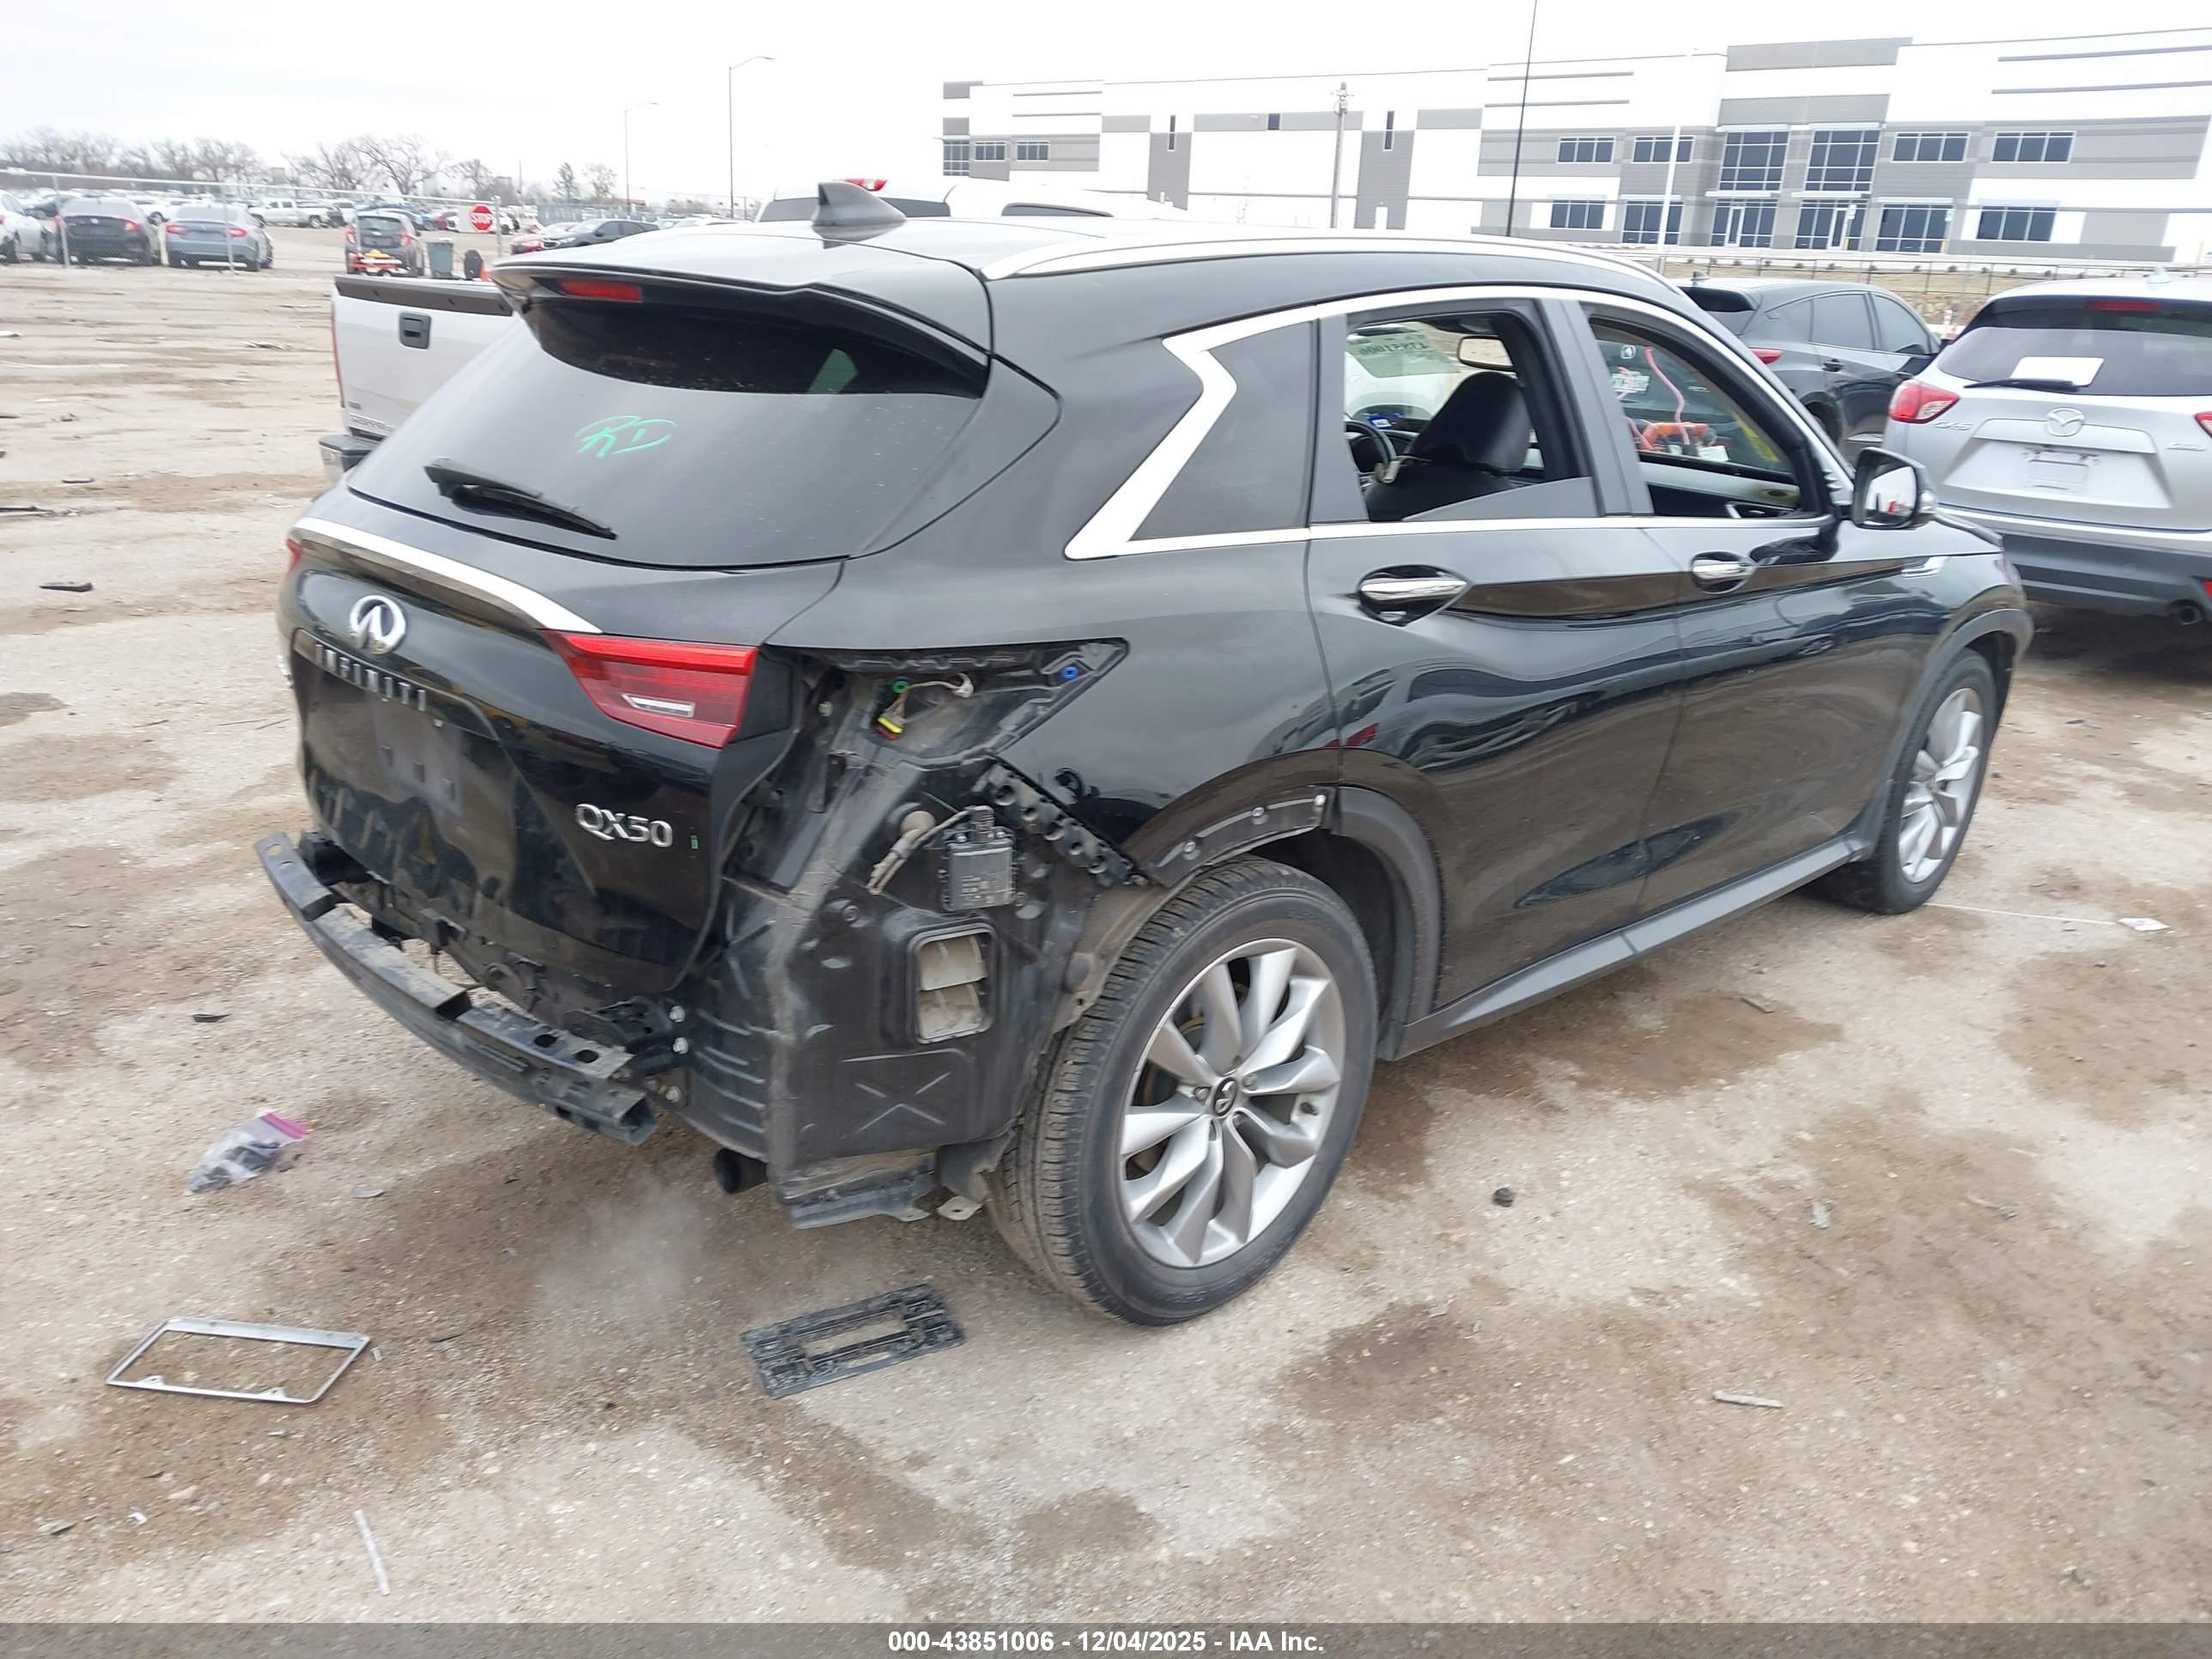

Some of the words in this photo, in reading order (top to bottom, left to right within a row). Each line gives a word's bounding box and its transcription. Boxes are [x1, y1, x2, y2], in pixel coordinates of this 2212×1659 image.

[471, 212, 495, 223] STOP
[315, 644, 427, 712] INFINITI
[575, 803, 673, 848] QX50
